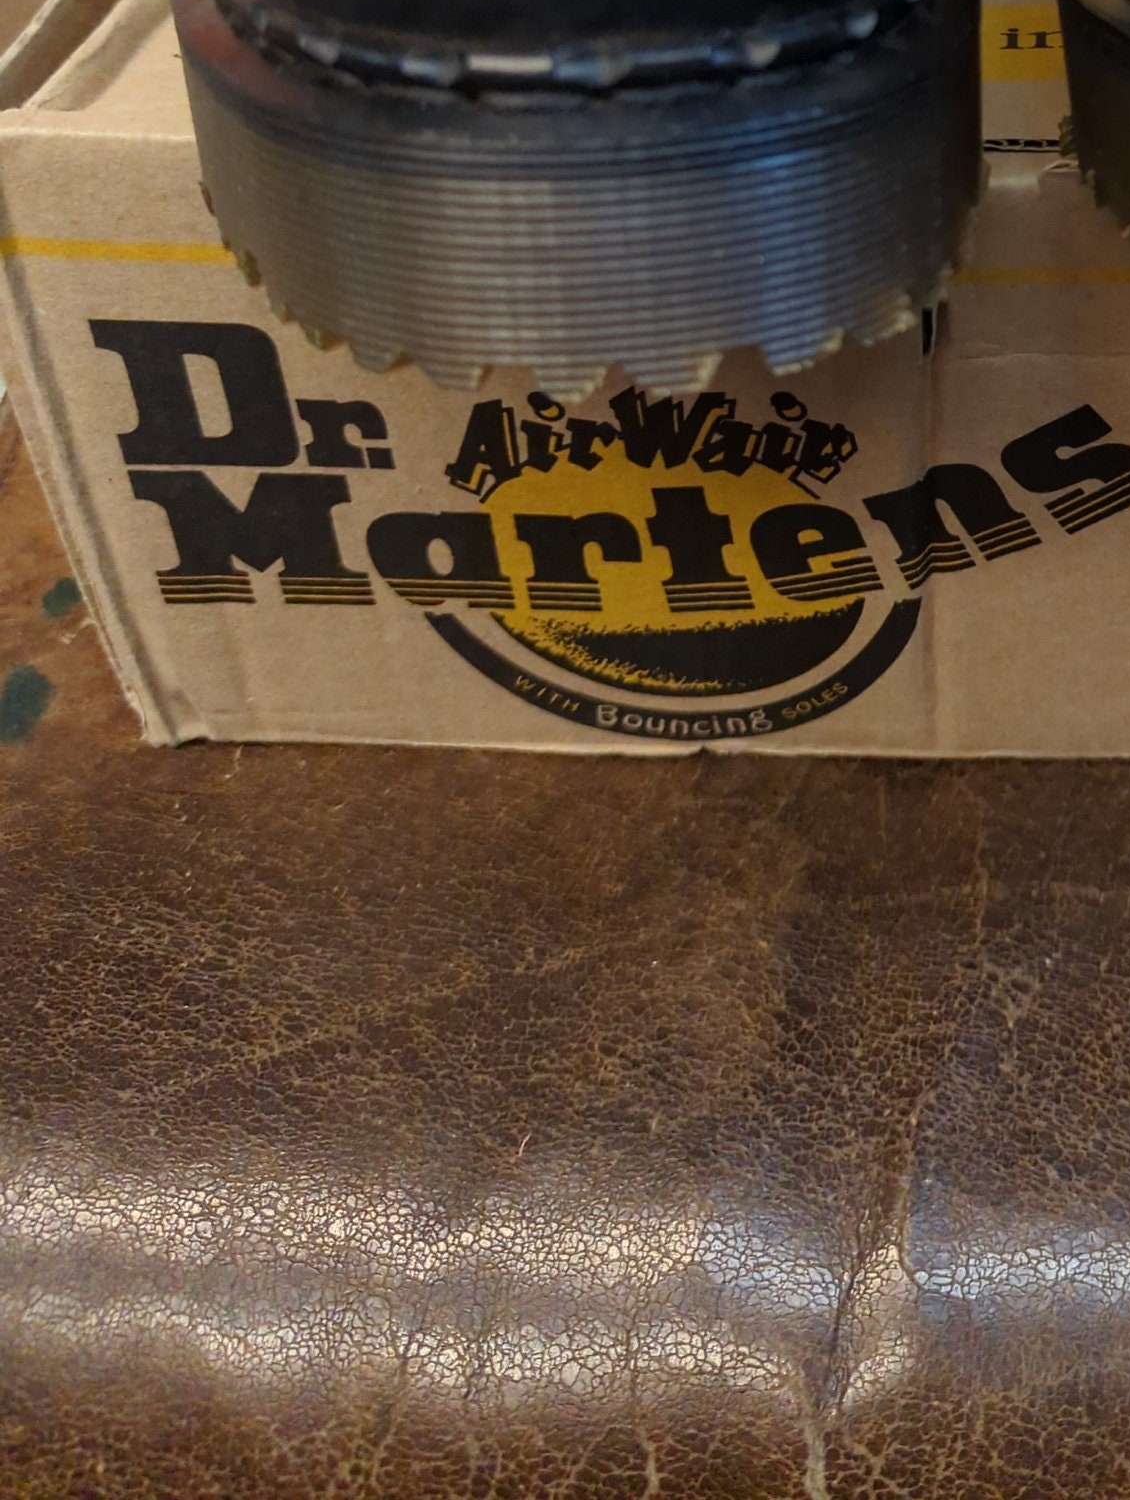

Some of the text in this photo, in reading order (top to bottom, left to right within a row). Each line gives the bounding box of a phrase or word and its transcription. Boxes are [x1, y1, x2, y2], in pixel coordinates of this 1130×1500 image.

[88, 318, 396, 470] Dr.
[444, 385, 859, 504] AirWair
[514, 674, 849, 737] WITH Bouncing SOLES
